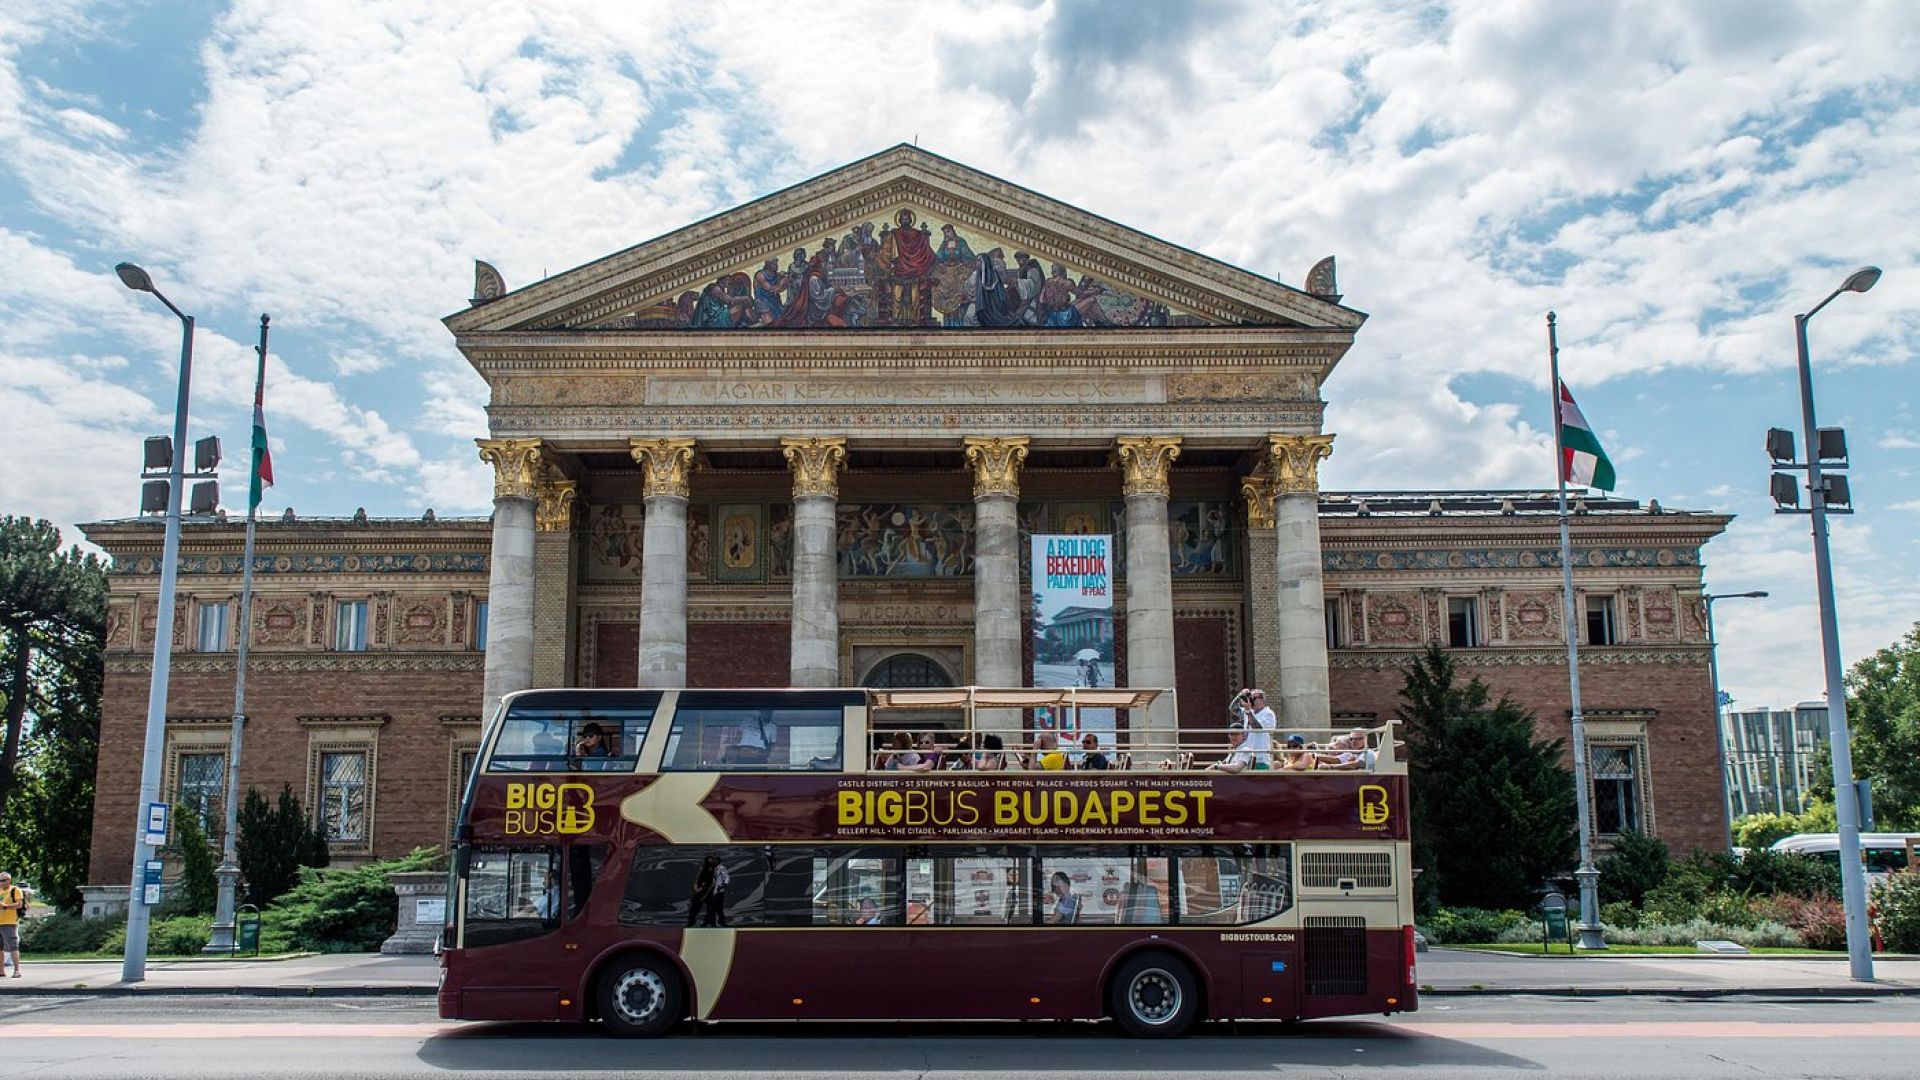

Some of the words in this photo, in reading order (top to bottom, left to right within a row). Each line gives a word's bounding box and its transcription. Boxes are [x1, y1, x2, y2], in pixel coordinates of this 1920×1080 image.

[700, 383, 782, 399] MAGYAR
[1047, 538, 1056, 556] A
[1058, 538, 1105, 557] BOLDOG
[1047, 574, 1079, 589] PALMY
[1081, 574, 1106, 588] DAYS
[837, 780, 865, 788] CASTLE
[867, 780, 899, 788] DISTRICT
[957, 780, 990, 788] BASILICA
[996, 780, 1010, 788] THE
[1011, 780, 1034, 788] ROYAL
[1036, 780, 1063, 788] PALACE
[1100, 780, 1128, 788] SQUARE
[1135, 780, 1149, 788] THE
[1150, 780, 1170, 788] MAIN
[1170, 780, 1213, 788] SYNAGOGUE
[507, 783, 555, 809] BIG
[994, 790, 1214, 826] BUDAPEST
[505, 811, 555, 834] BUS
[870, 827, 886, 835] HILL
[892, 827, 905, 835] THE
[907, 827, 936, 835] CITADEL
[943, 827, 987, 835] PARLIAMENT
[993, 827, 1031, 835] MARGARET
[1032, 827, 1059, 835] ISLAND
[1114, 827, 1145, 835] BASTION
[1150, 827, 1164, 835] THE
[1165, 827, 1190, 835] OPERA
[1190, 827, 1214, 835] HOUSE
[1220, 933, 1295, 942] BIGBUSTOURS.COM
